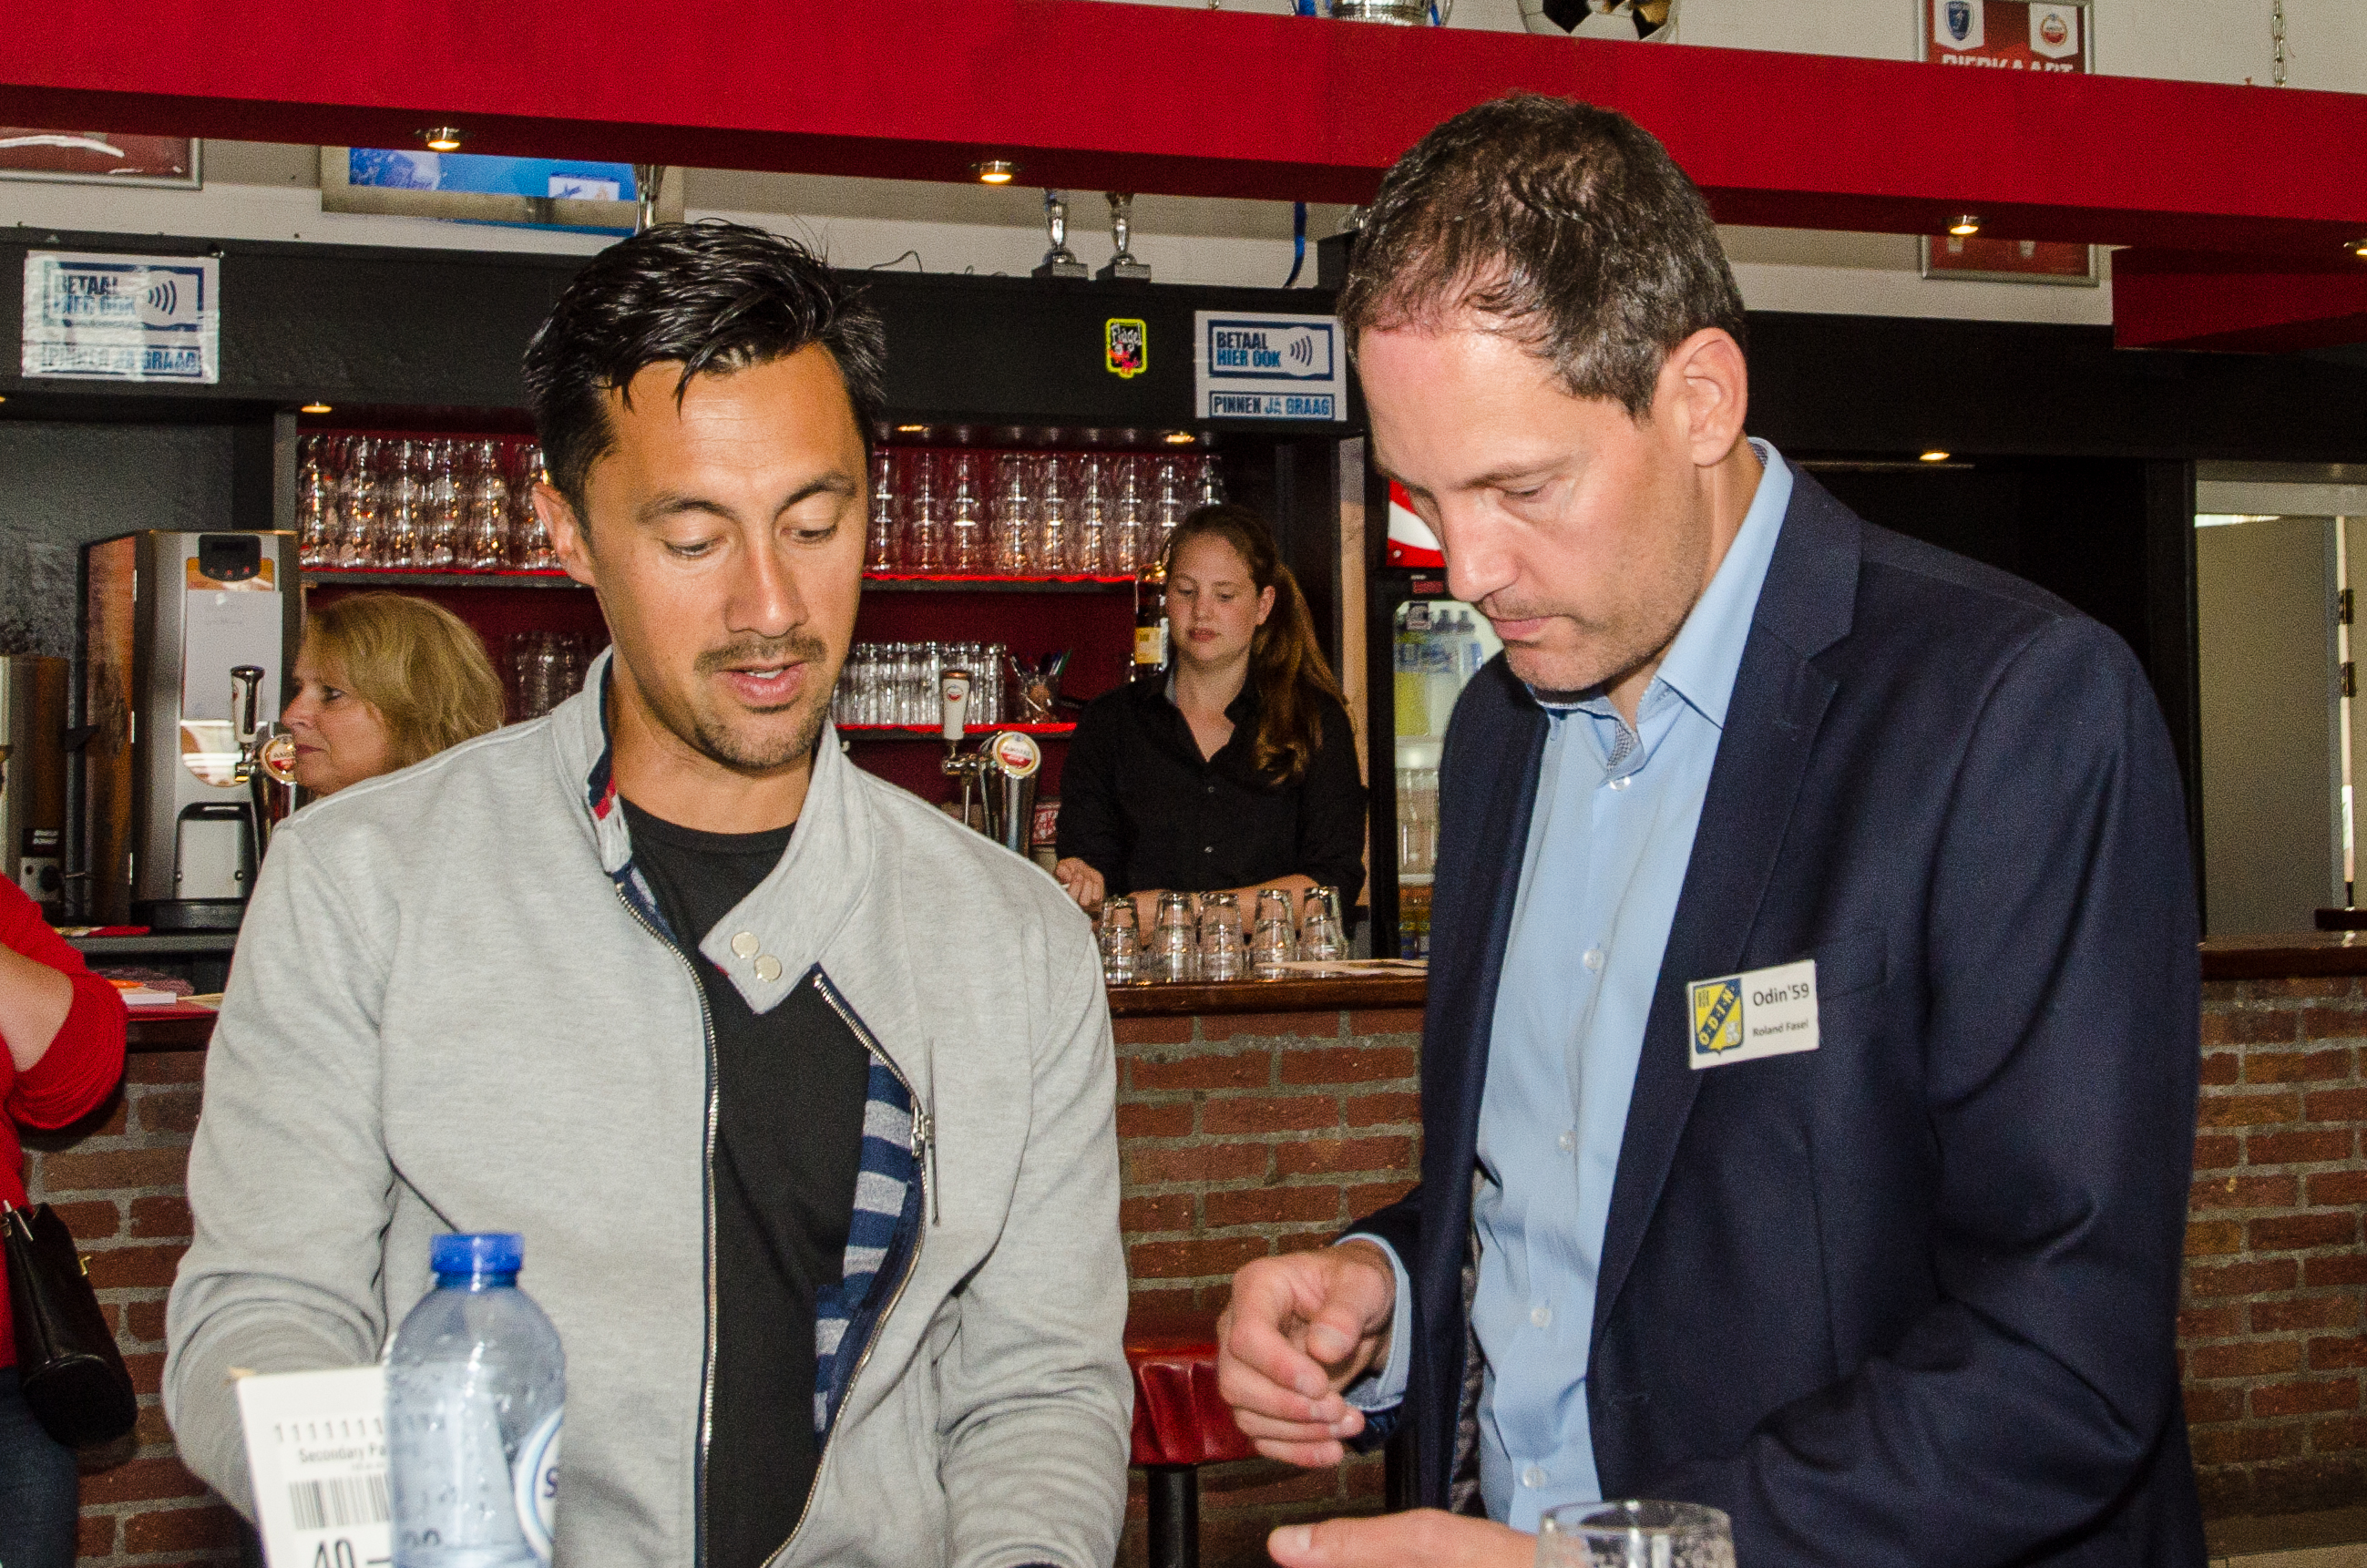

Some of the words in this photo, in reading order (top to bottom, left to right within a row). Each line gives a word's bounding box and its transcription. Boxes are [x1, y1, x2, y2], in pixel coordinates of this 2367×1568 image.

[1216, 331, 1268, 350] BETAAL
[1216, 349, 1248, 366] HIER
[1252, 350, 1281, 367] OOK
[1214, 396, 1261, 414] PINNEN
[1286, 397, 1330, 415] GRAAG
[1753, 1022, 1784, 1038] Roland
[298, 1443, 364, 1464] Secondary
